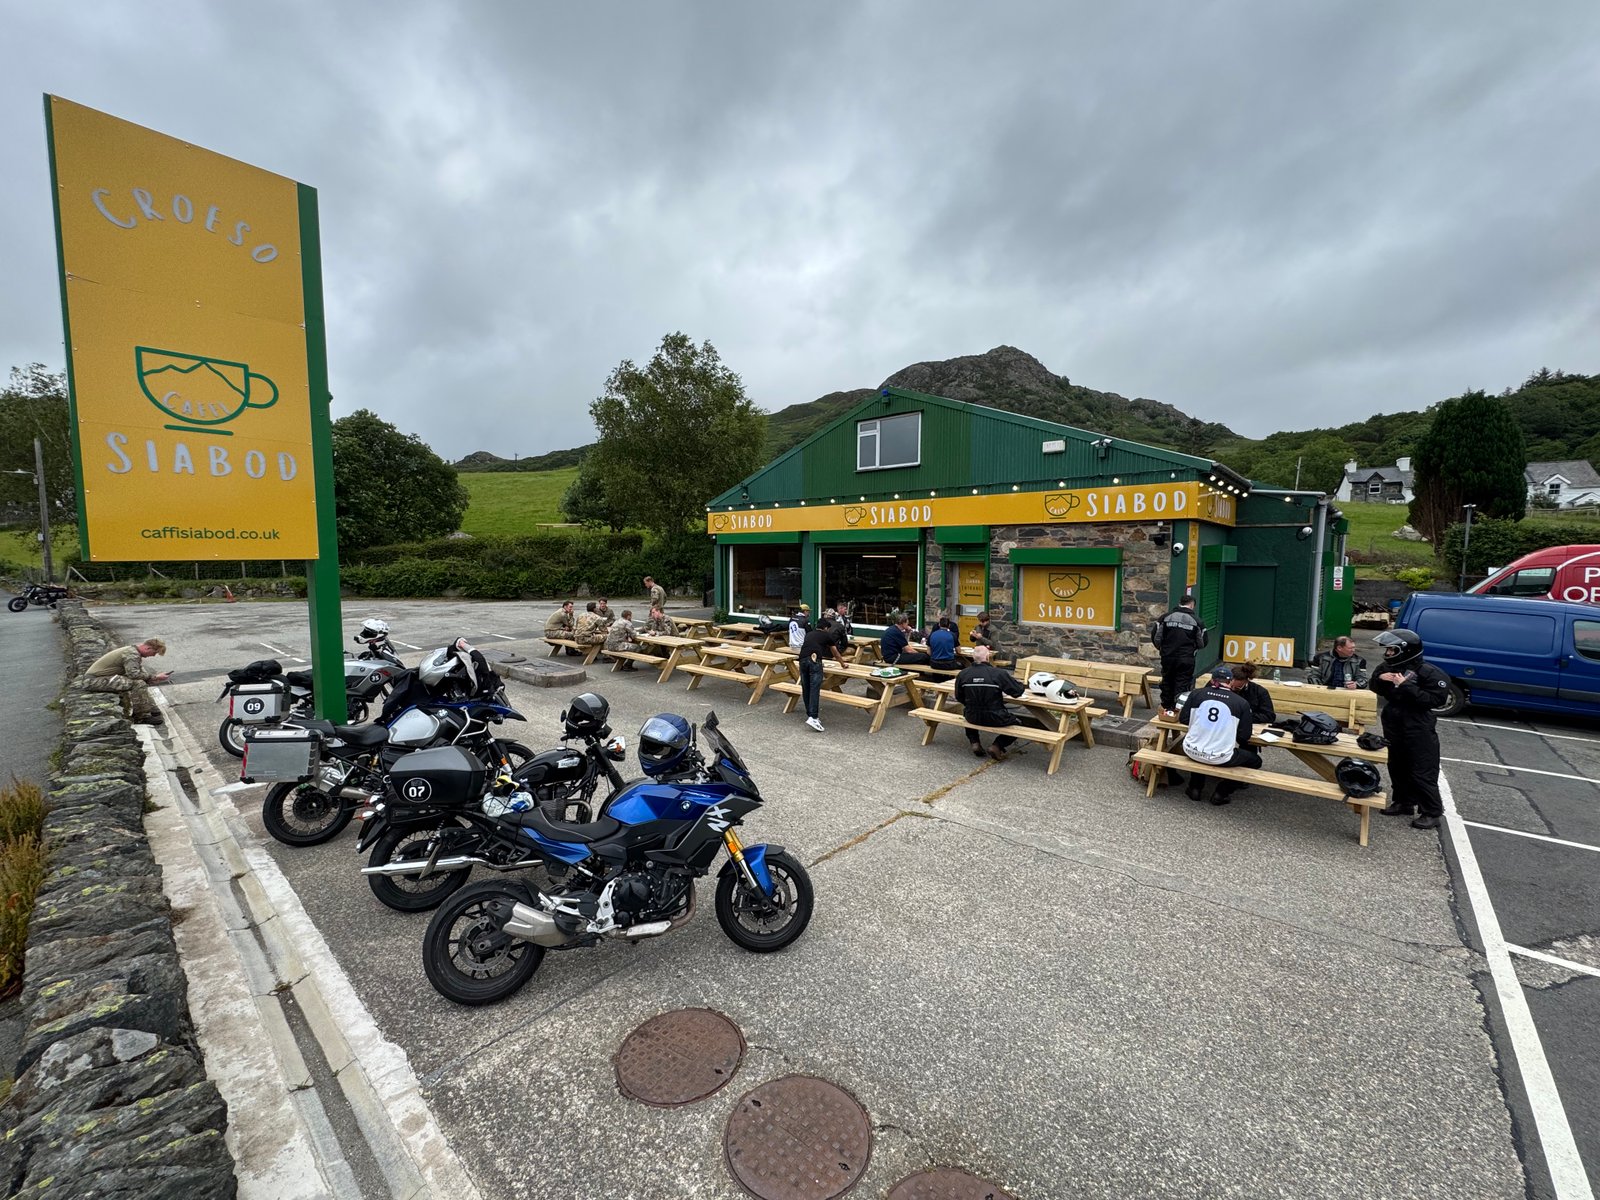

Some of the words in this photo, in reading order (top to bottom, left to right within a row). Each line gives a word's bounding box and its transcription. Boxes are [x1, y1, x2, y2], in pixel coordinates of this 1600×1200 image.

[91, 187, 279, 263] CROESO
[163, 391, 231, 417] CAFFI
[106, 432, 298, 481] SIABOD
[1086, 490, 1187, 517] SIABOD
[731, 514, 772, 530] SIABOD
[870, 505, 931, 525] SIABOD
[141, 527, 280, 540] caffisiabod.co.uk
[1038, 602, 1095, 620] SIABOD
[1226, 639, 1291, 662] OPEN
[247, 702, 261, 711] 09
[1207, 707, 1220, 722] 8
[409, 786, 425, 798] 07
